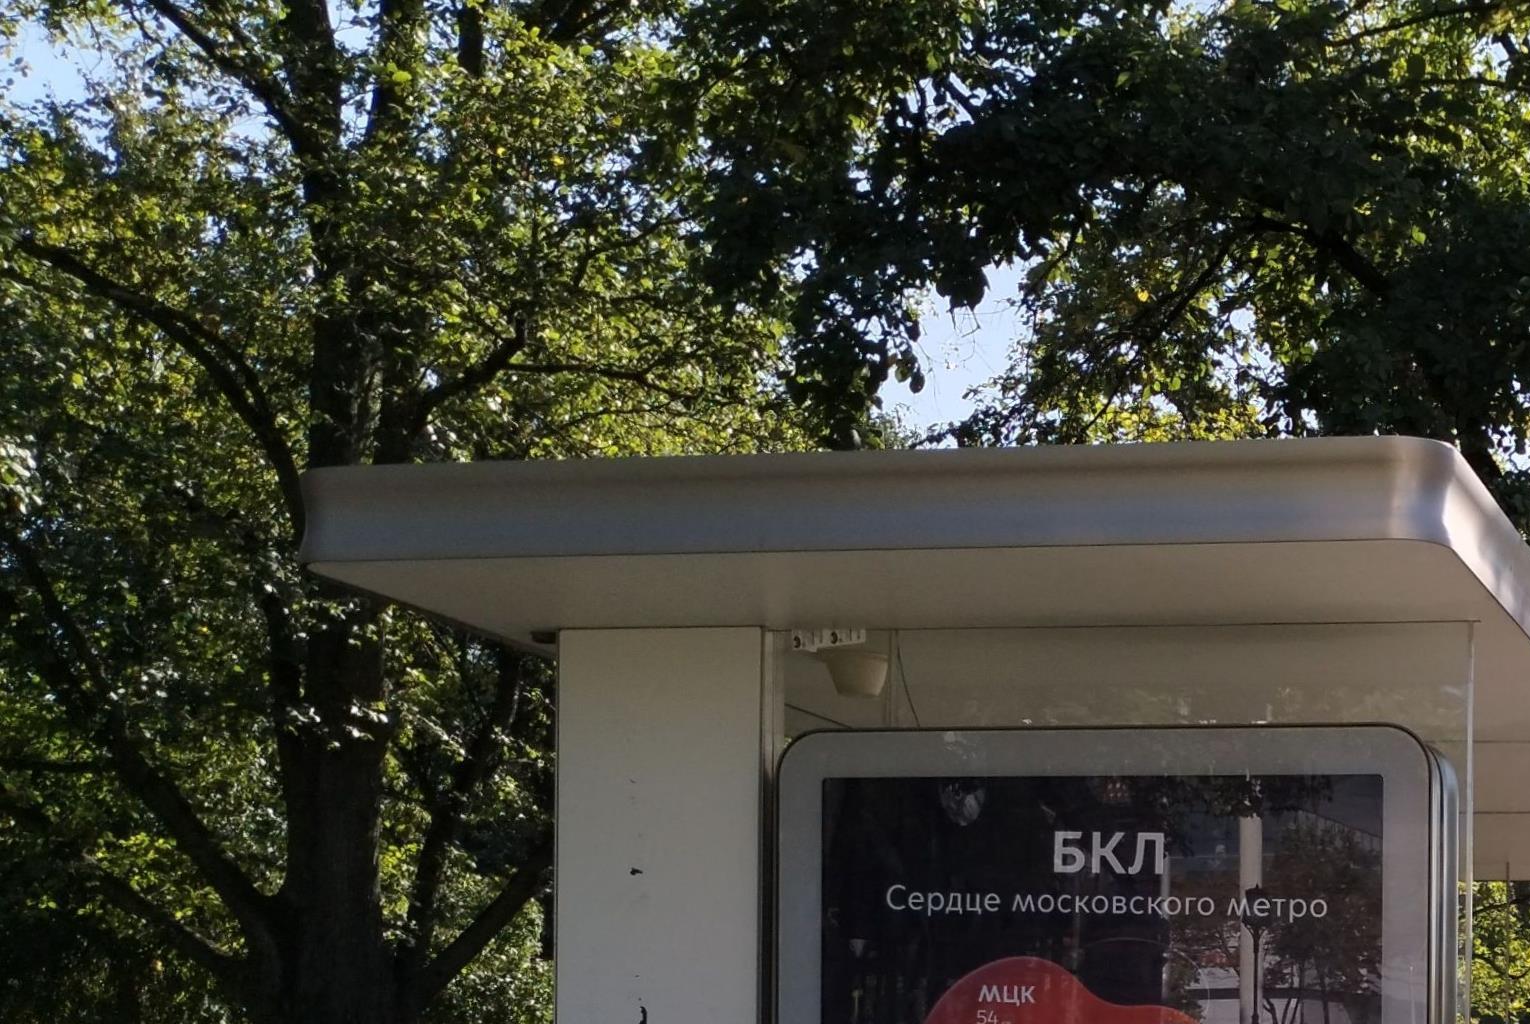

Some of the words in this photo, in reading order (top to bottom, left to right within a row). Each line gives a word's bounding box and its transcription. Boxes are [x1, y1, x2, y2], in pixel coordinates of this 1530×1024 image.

[1053, 831, 1167, 876] БКЛ
[886, 884, 1001, 918] Сердце
[1012, 890, 1215, 919] московского
[1227, 896, 1328, 922] метро
[978, 984, 1036, 1007] МЦК
